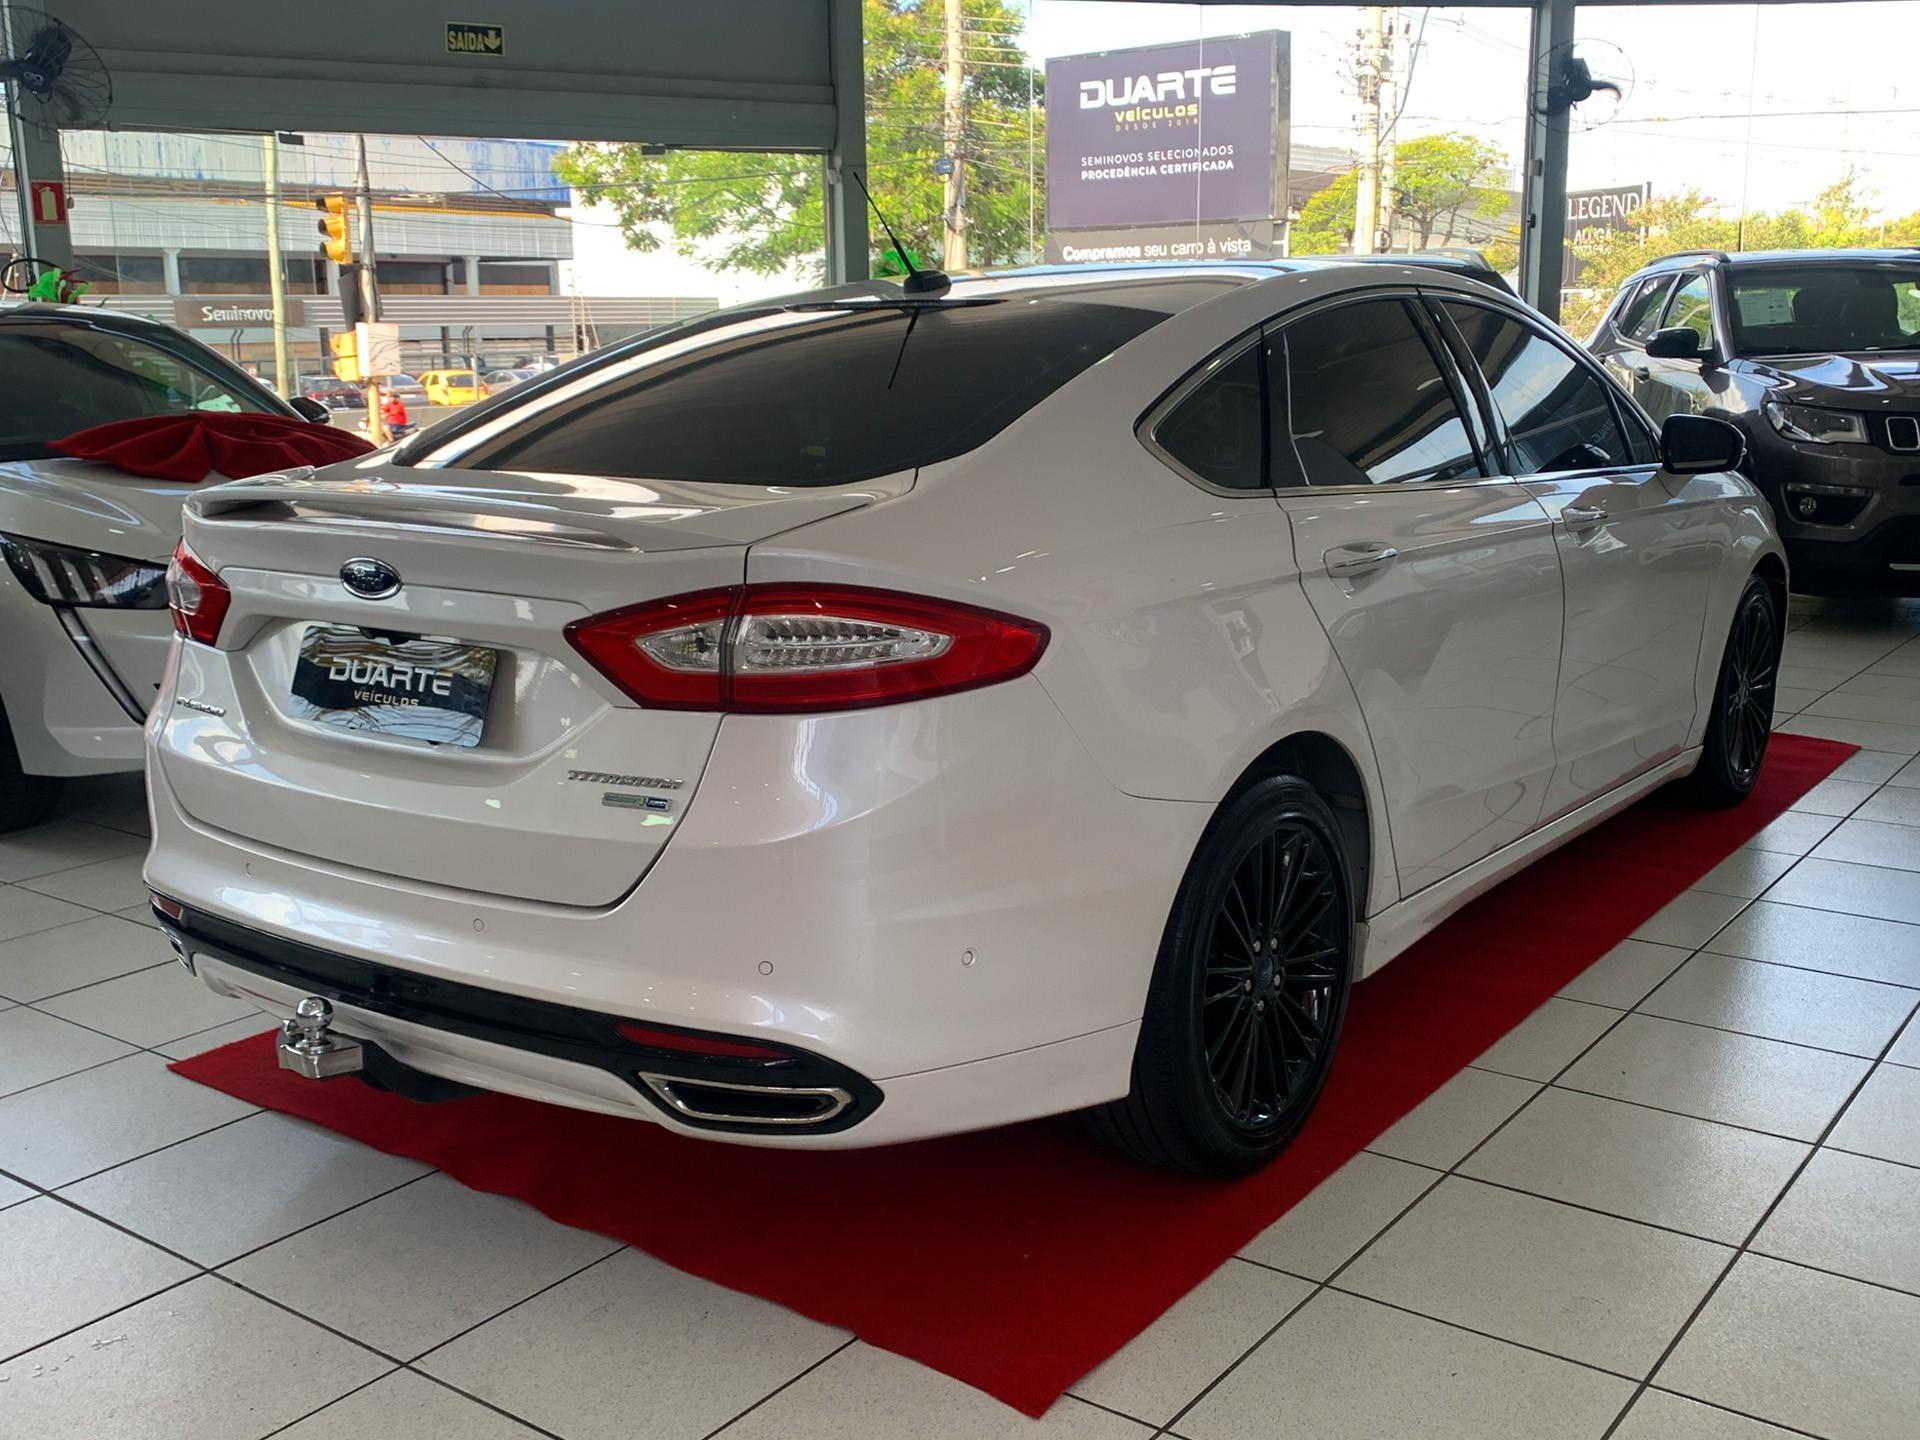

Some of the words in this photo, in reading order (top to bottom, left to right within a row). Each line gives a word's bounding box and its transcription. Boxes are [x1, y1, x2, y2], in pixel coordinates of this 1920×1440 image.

[448, 26, 485, 52] SAÍDA
[1079, 64, 1237, 110] DUARTE
[1114, 103, 1199, 123] VEÍCULOS
[1114, 121, 1158, 132] DESDE
[1080, 152, 1144, 167] SEMINOVOS
[1147, 144, 1234, 162] SELECIONADOS
[1080, 164, 1157, 181] PROCEDÊNCIA
[1160, 159, 1234, 174] CERTIFICADA
[1567, 192, 1640, 220] LEGEND
[1062, 245, 1142, 262] Compramos
[1144, 243, 1167, 257] seu
[1170, 240, 1204, 256] carro
[1207, 237, 1217, 254] à
[1219, 236, 1252, 253] vista
[201, 305, 276, 322] Seminovo
[329, 656, 454, 697] DUARTE
